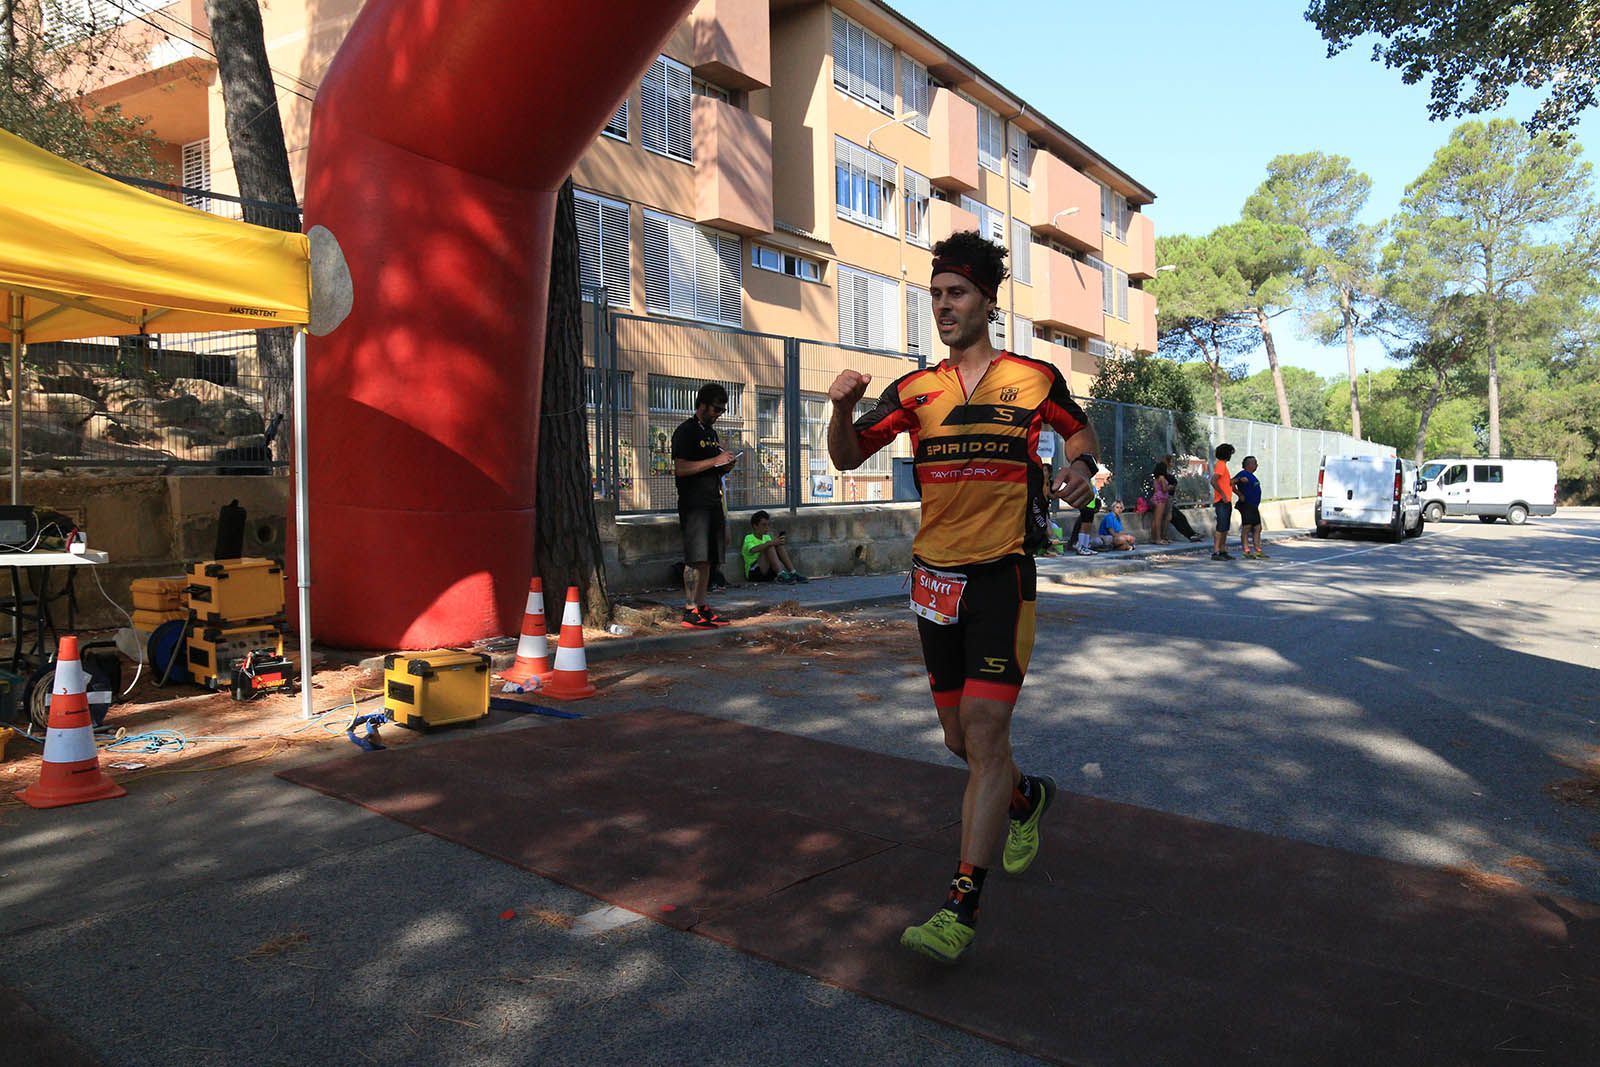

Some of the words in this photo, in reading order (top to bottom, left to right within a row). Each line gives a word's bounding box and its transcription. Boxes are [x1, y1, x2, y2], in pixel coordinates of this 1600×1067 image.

[230, 307, 277, 318] MASTERTENT
[930, 467, 998, 479] TAYMORY
[920, 575, 951, 595] SANTI
[929, 595, 937, 608] 2
